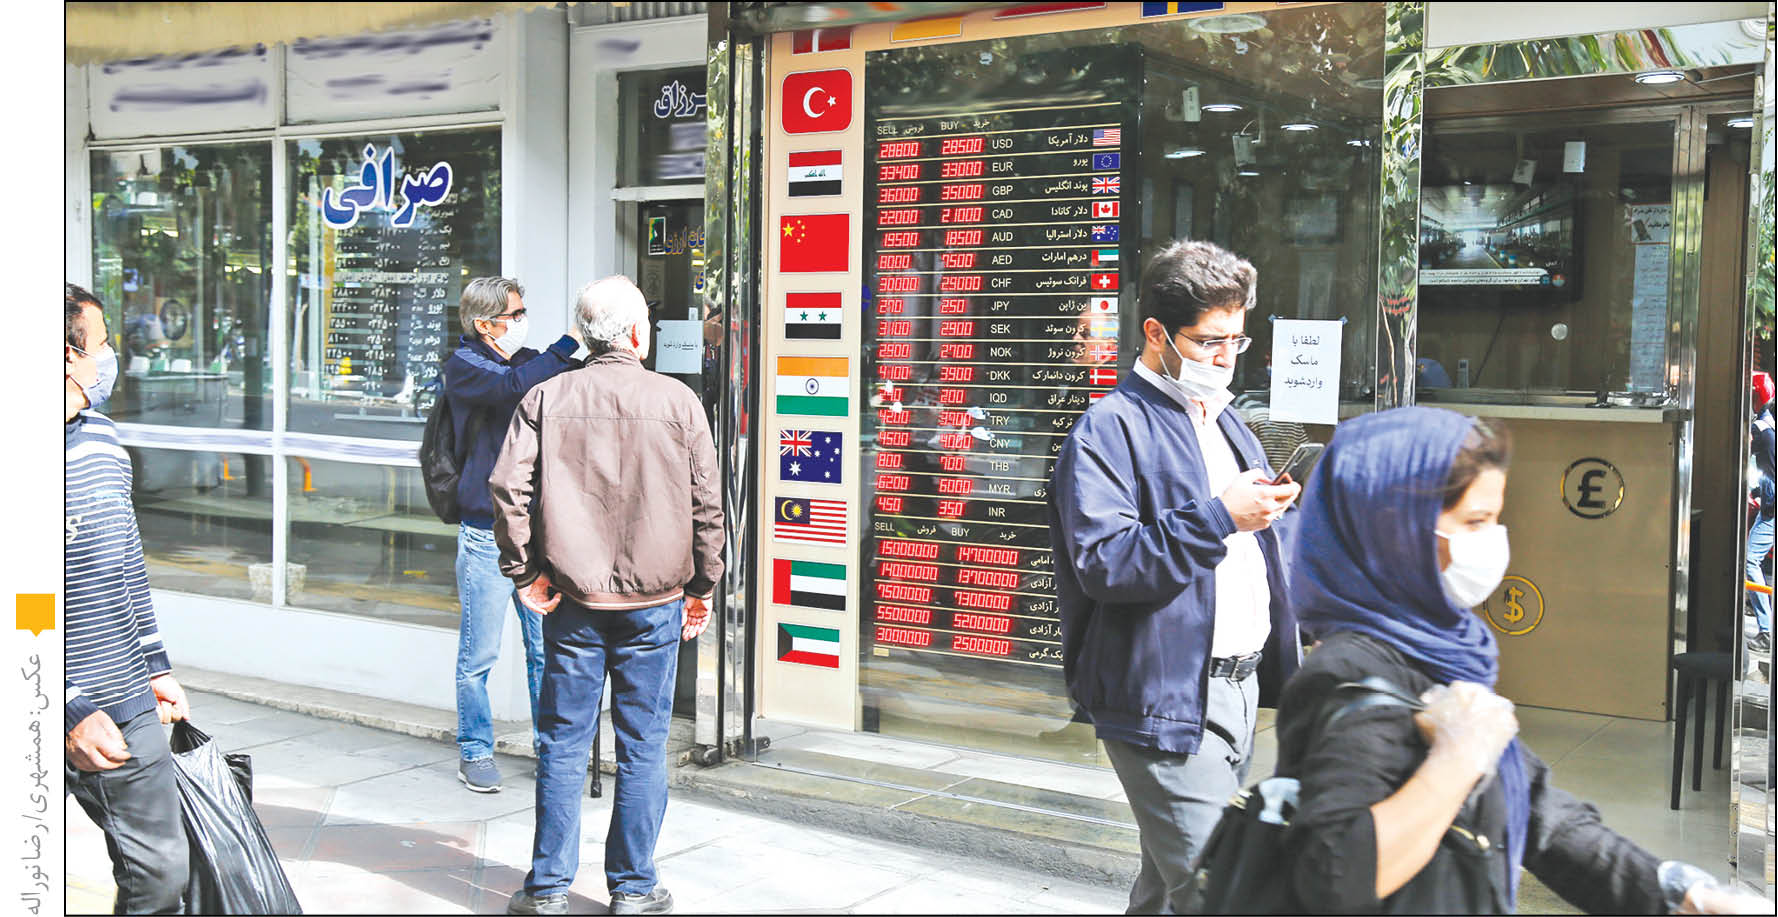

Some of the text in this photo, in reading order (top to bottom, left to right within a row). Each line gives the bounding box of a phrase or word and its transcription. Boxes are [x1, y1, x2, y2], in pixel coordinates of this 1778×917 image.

[876, 125, 898, 135] SELL
[941, 121, 959, 130] BUY
[1048, 133, 1088, 146] دلار آمریکا
[880, 138, 1013, 157] 28800 28500 USD
[1073, 158, 1088, 167] یورو
[880, 161, 1013, 180] 33400 33000 EUR
[323, 143, 453, 229] صرافی
[1045, 181, 1088, 194] پوند انگلیس
[880, 184, 1013, 202] 36000 35000 GBP
[880, 207, 1013, 224] 22000 21000 CAD
[1051, 206, 1088, 216] دلار کانادا
[883, 231, 1013, 246] 19500 18500 AUD
[1046, 230, 1088, 240] دلار استرالیا
[879, 253, 1012, 268] 8000 7500 AED
[1042, 253, 1087, 264] درهم امارات
[880, 276, 1012, 291] 30000 29000 CHF
[1061, 277, 1087, 286] فرانک
[941, 299, 966, 313] 250
[991, 301, 1010, 311] JPY
[879, 321, 1010, 336] 3100 2900 SEK
[1045, 324, 1085, 336] کرون سوئد
[1292, 336, 1320, 346] لطفا با
[940, 344, 972, 359] 2700
[990, 347, 1011, 357] NOK
[1065, 347, 1085, 358] کرون
[1291, 354, 1318, 366] ماسک
[879, 366, 1010, 381] 4100 3900 DKK
[1064, 372, 1085, 383] کرون
[940, 390, 965, 404] 200
[990, 393, 1007, 403] IQD
[1048, 393, 1085, 406] دینار عراق
[990, 416, 1010, 425] TRY
[878, 432, 909, 446] 4500
[990, 439, 1010, 448] CNY
[878, 453, 1009, 471] 800 700 THB
[877, 475, 1010, 494] 6200 6000 MYR
[878, 498, 1005, 516] 450 350 INR
[874, 522, 895, 531] SELL
[917, 526, 937, 535] فروش
[951, 527, 969, 537] BUY
[1000, 531, 1017, 540] خرید
[881, 541, 1018, 565] 15000000 14700000
[1030, 555, 1050, 566] امامی
[881, 563, 1018, 588] 14000000 13700000
[1030, 576, 1052, 589] آزادی
[878, 584, 1011, 610] 7500000 7300000
[1029, 600, 1052, 612] آزادی
[877, 606, 1011, 632] 5500000 5200000
[1029, 625, 1052, 635] آزادی
[877, 627, 1011, 655] 3000000 2500000
[1028, 647, 1049, 660] گرمی
